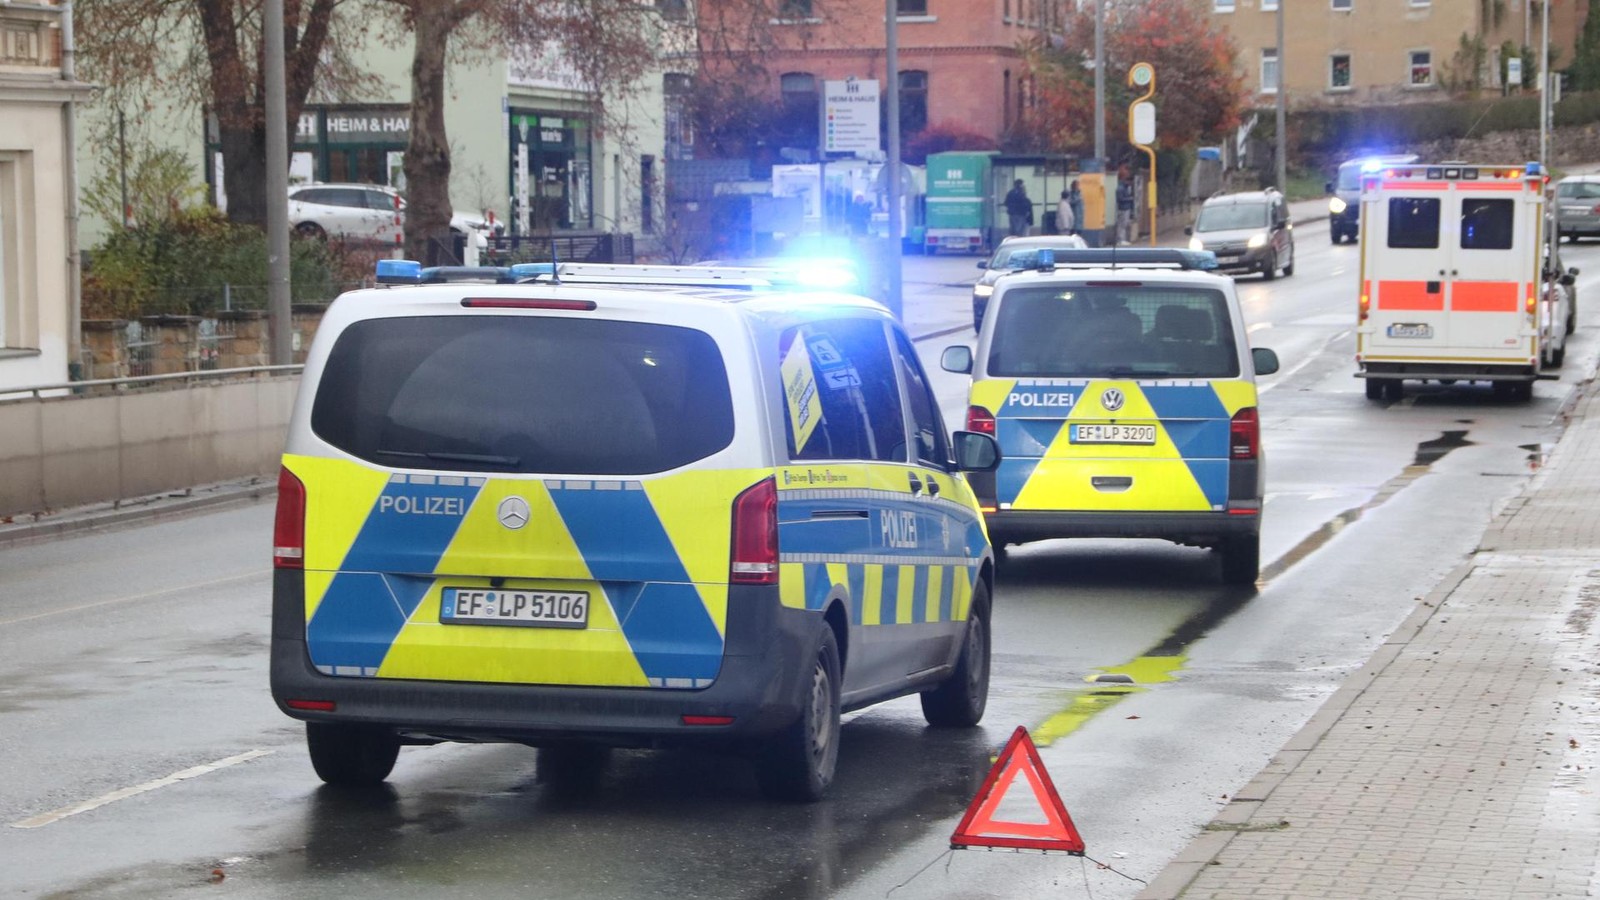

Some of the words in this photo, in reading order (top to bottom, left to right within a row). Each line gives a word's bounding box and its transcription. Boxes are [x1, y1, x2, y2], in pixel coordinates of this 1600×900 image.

[327, 117, 367, 132] HEIM
[369, 117, 381, 132] &
[383, 117, 410, 132] HA
[1009, 392, 1074, 407] POLIZEI
[1078, 426, 1094, 440] EF
[1103, 426, 1119, 440] LP
[1122, 426, 1154, 441] 3290
[380, 495, 464, 516] POLIZEI
[880, 509, 918, 549] POLIZEI
[456, 592, 484, 616] EF
[500, 593, 526, 618] LP
[531, 594, 583, 619] 5106
